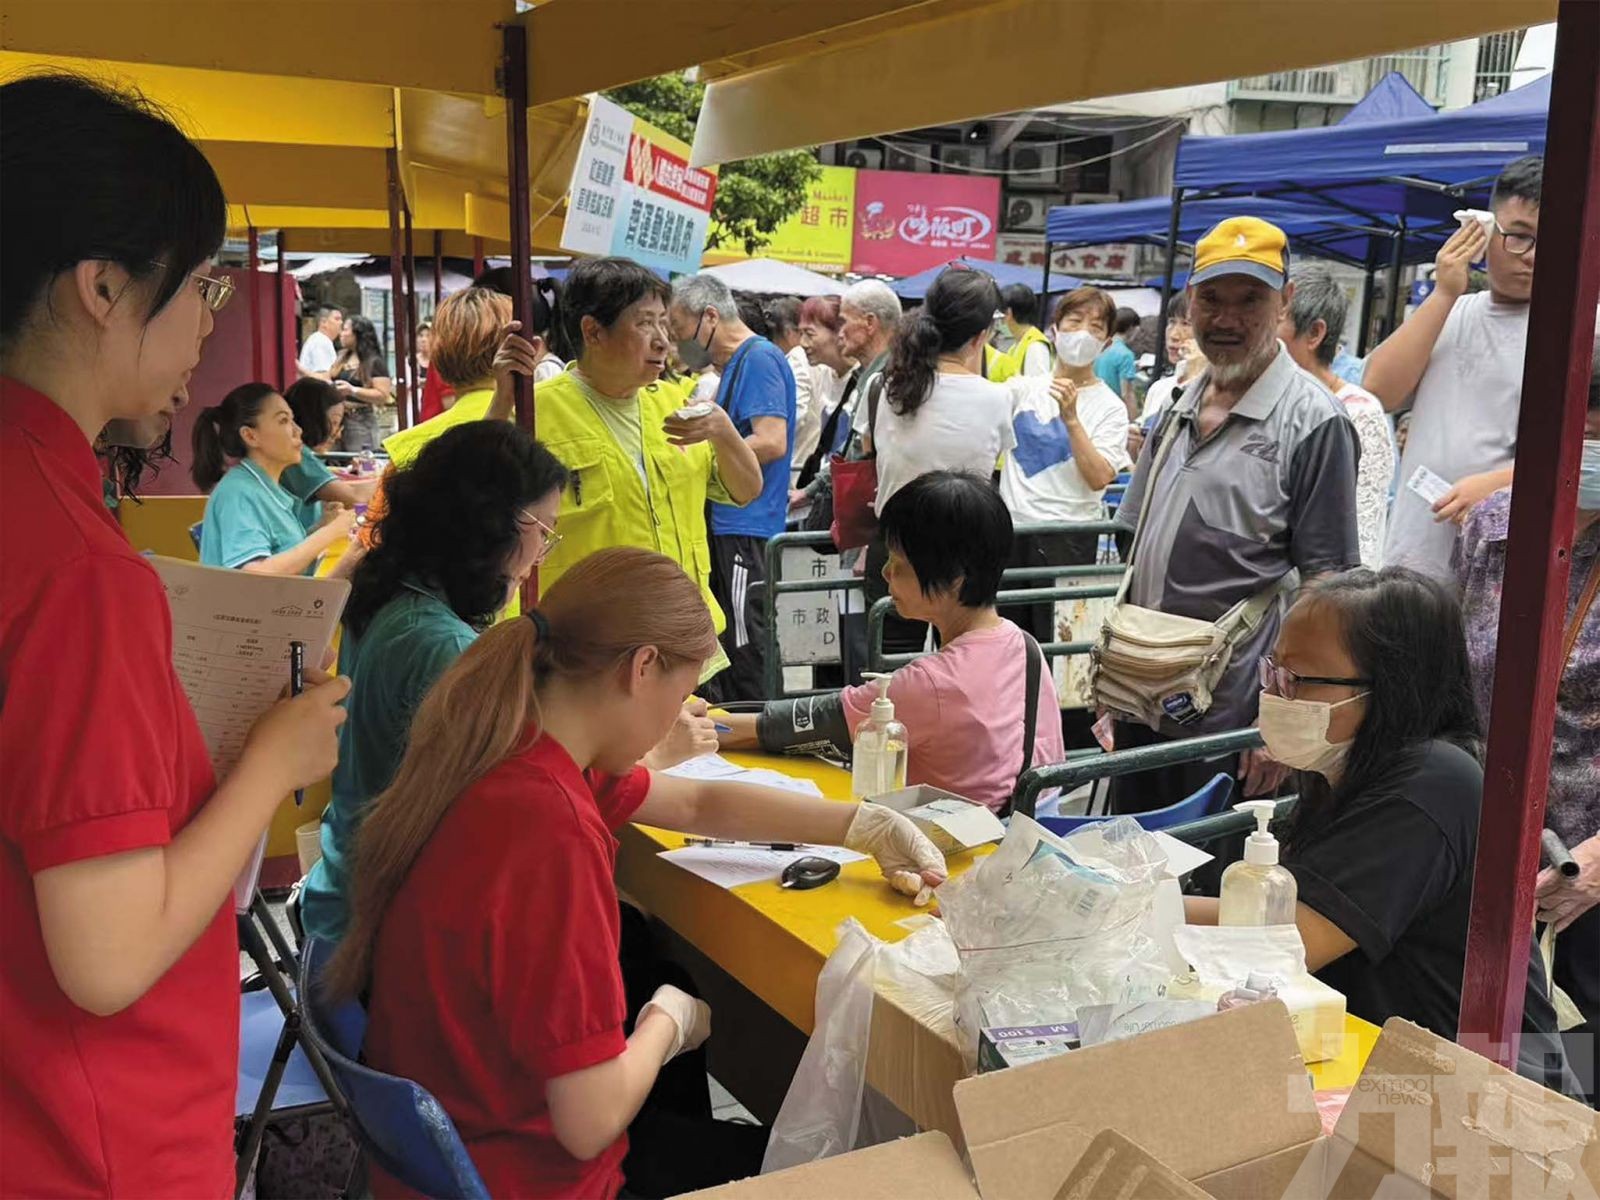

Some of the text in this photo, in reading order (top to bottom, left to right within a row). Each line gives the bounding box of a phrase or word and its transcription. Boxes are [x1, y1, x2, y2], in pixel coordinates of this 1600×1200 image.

[800, 204, 849, 228] 超市
[812, 557, 828, 578] 市
[792, 607, 830, 626] 市政
